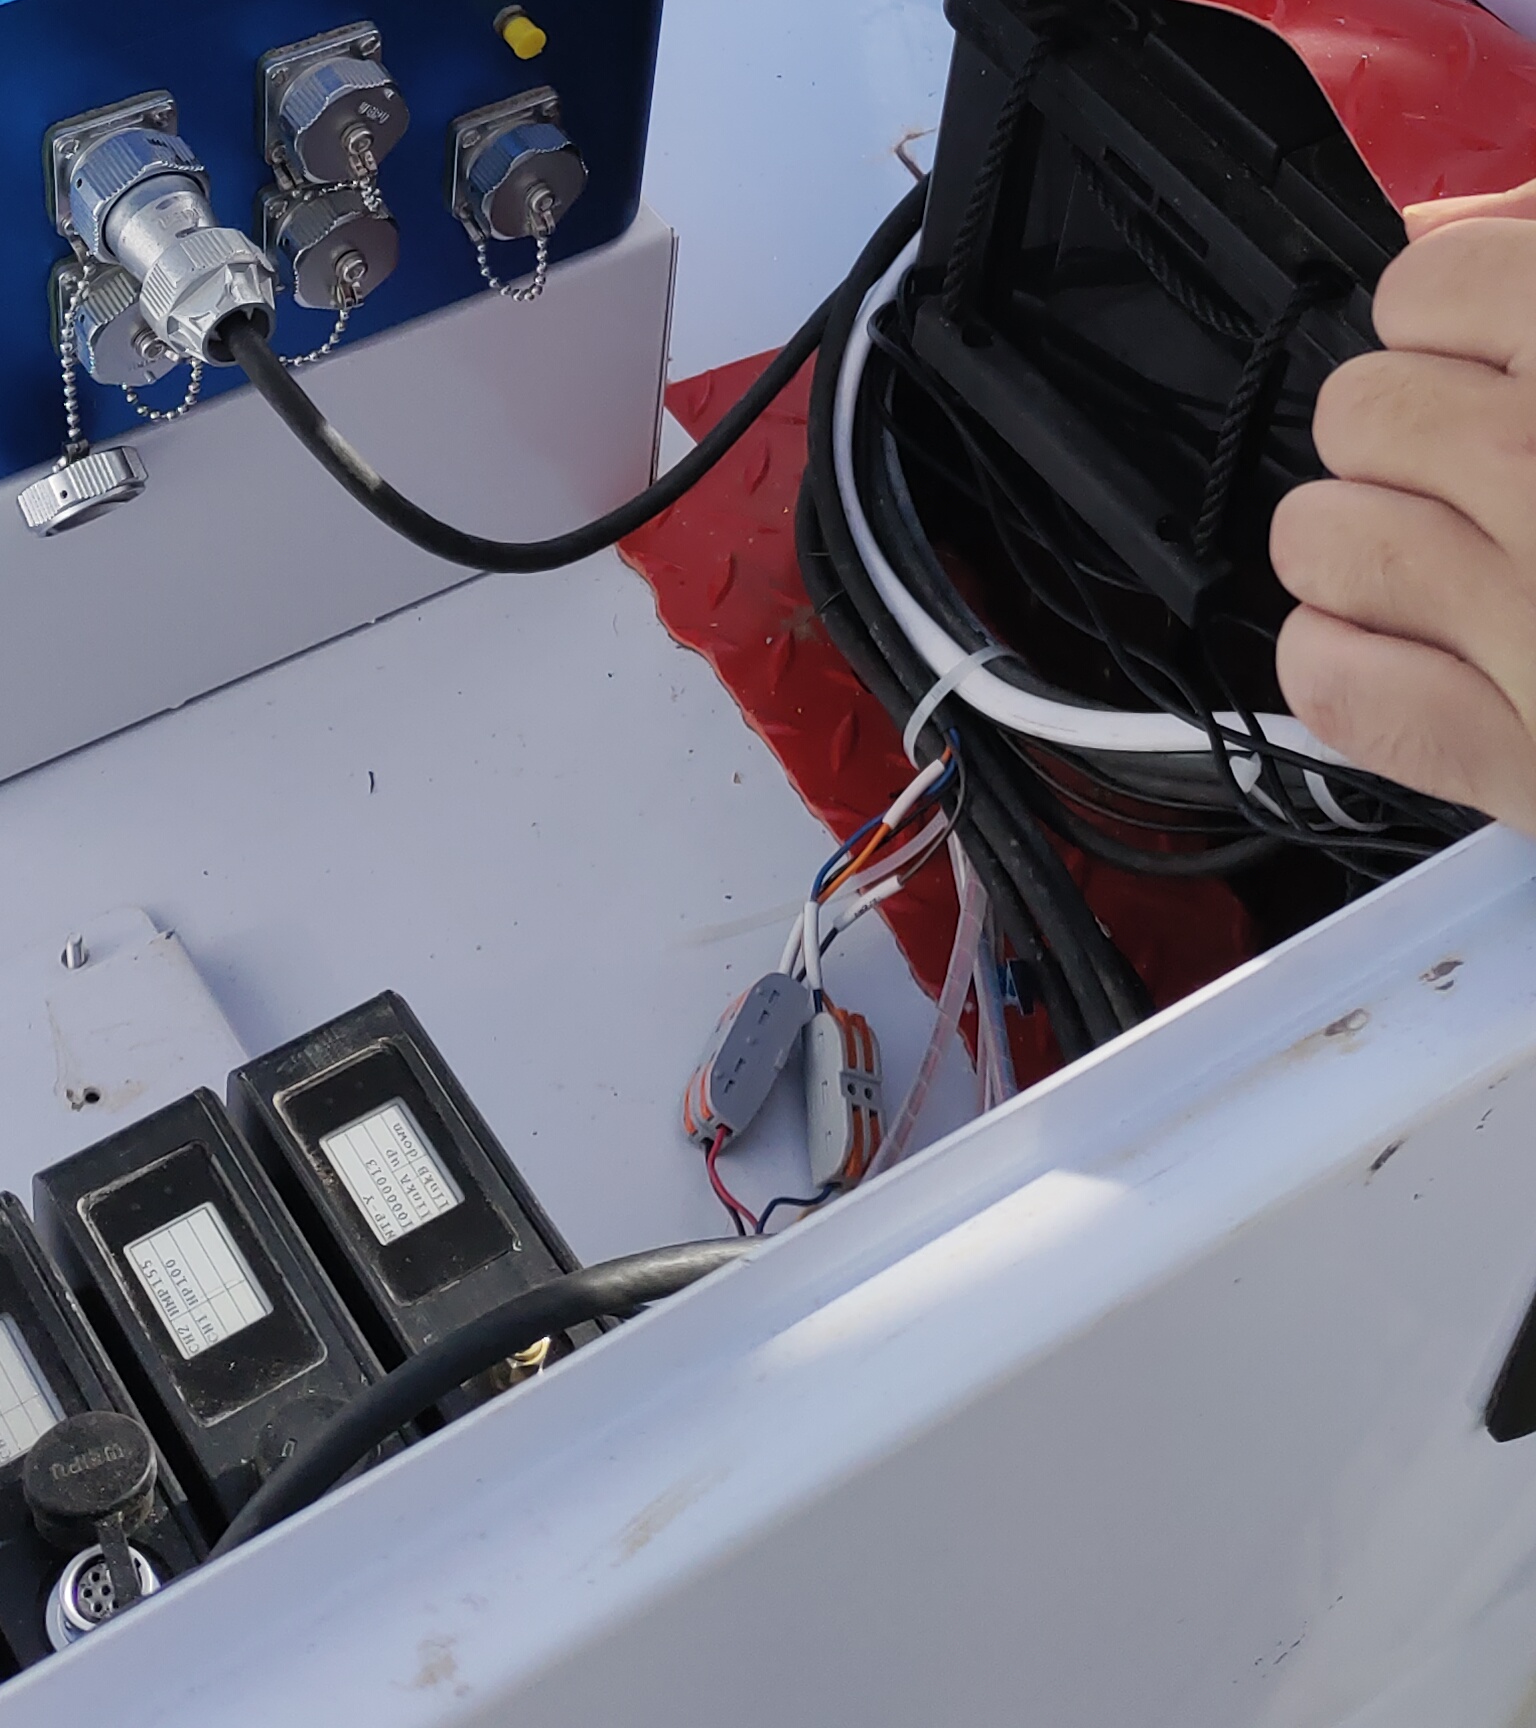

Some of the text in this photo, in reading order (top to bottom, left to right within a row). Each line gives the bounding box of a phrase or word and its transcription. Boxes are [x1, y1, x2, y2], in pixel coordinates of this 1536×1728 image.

[386, 1149, 400, 1168] up
[393, 1123, 418, 1158] down
[363, 1195, 396, 1239] NTP-Y
[141, 1260, 200, 1354] CH2 HMP155
[165, 1259, 219, 1343] CH1 HP100
